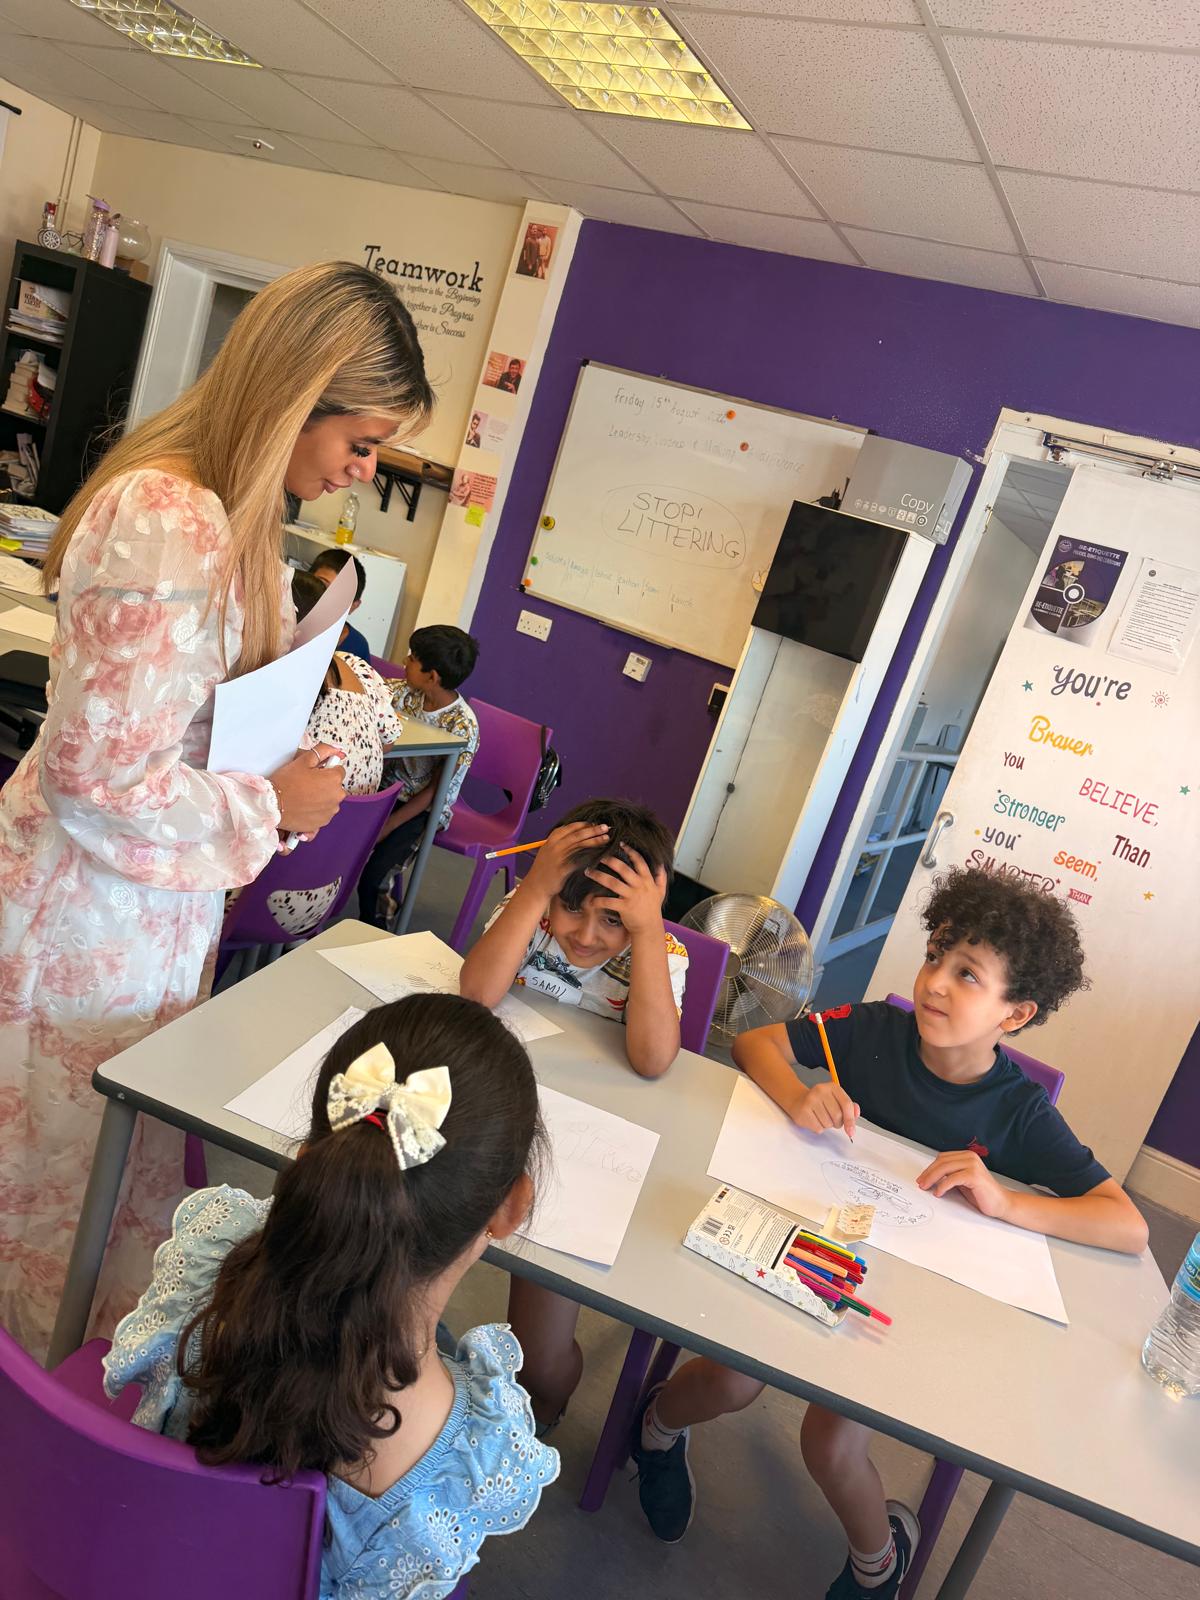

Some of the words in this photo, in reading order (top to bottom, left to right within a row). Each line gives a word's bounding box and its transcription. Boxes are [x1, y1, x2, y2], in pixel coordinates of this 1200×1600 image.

[364, 245, 484, 292] Teamwork
[444, 287, 481, 306] Beginning
[440, 302, 474, 322] Progress
[435, 320, 466, 338] Success
[900, 493, 934, 514] Copy
[617, 508, 740, 559] LITTERING
[1028, 715, 1094, 757] Braver
[1004, 751, 1025, 770] You
[993, 794, 1066, 832] Stronger
[1079, 777, 1159, 827] BELIEVE,
[1112, 834, 1151, 868] Than
[1070, 888, 1090, 904] THAN
